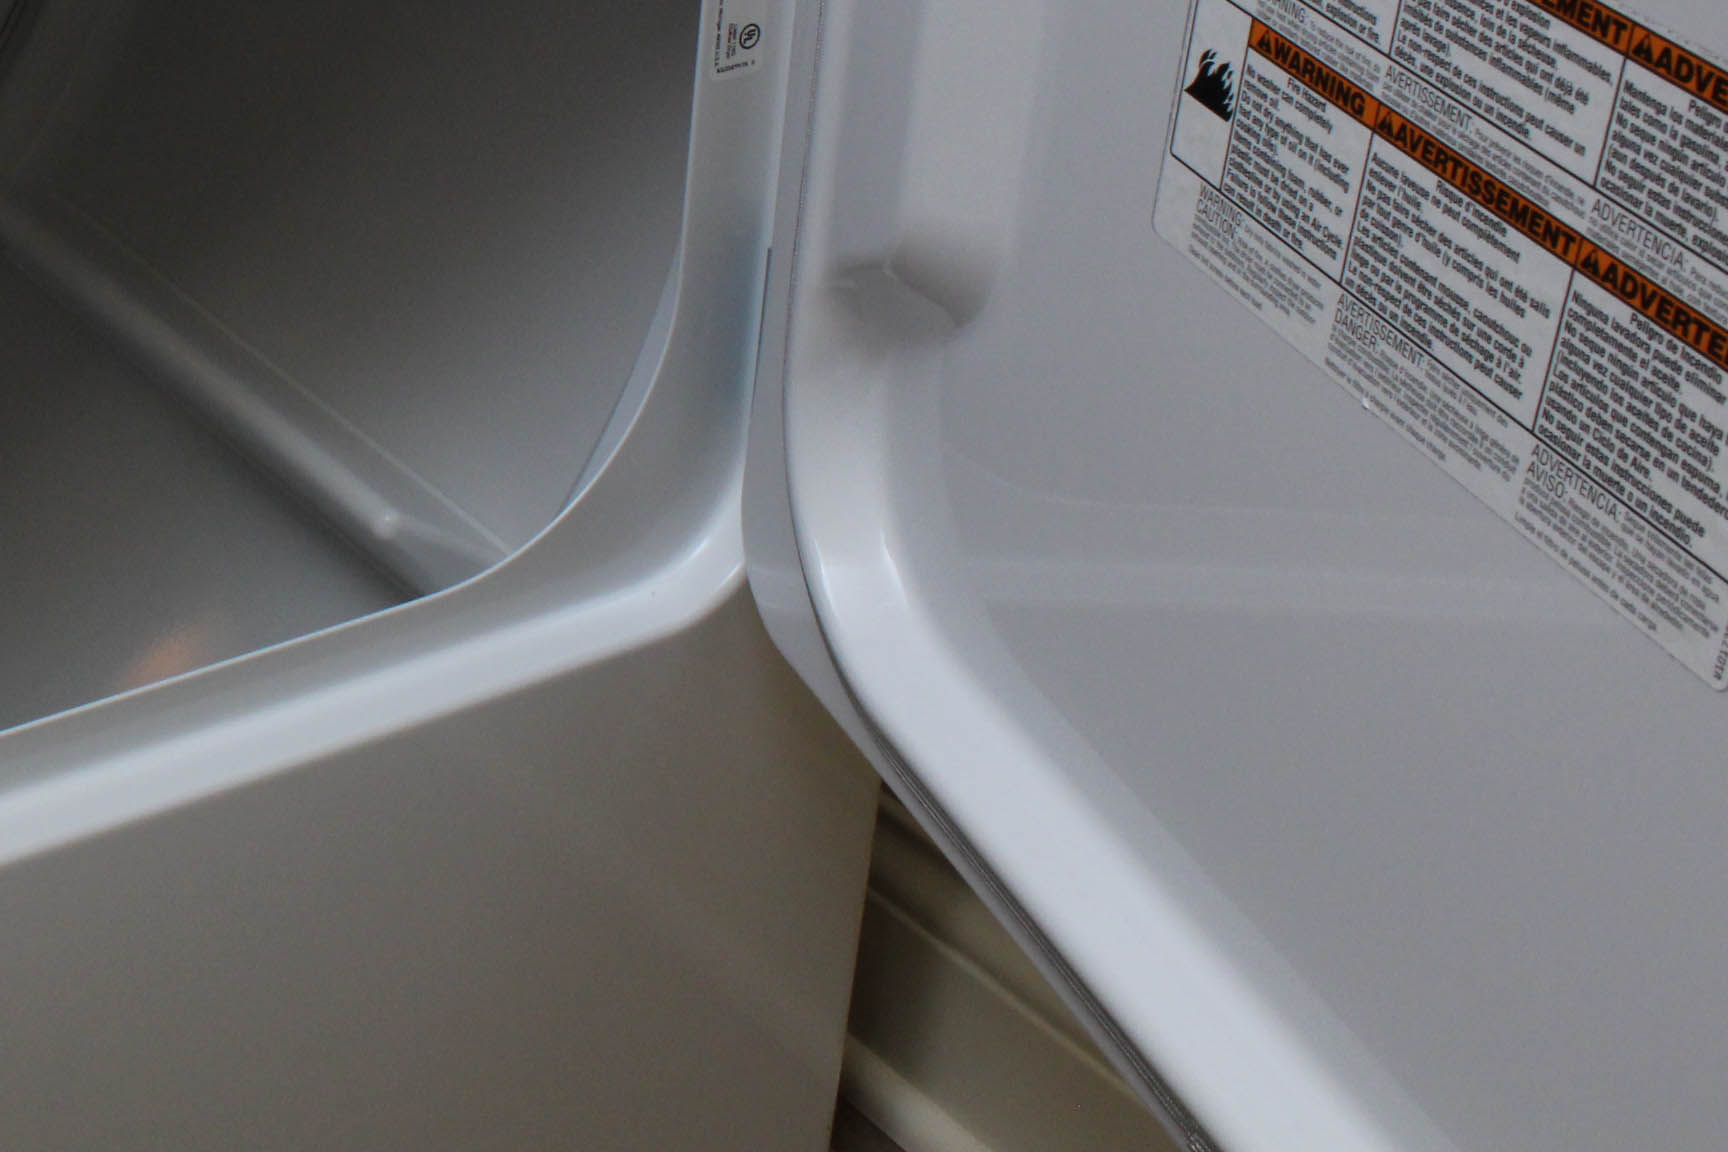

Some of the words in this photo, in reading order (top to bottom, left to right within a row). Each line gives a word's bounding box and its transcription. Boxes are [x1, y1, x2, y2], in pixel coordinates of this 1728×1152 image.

[1271, 36, 1367, 118] WARNING
[1393, 118, 1577, 261] AVERTISSEMENT
[1601, 257, 1728, 364] ADVERTE
